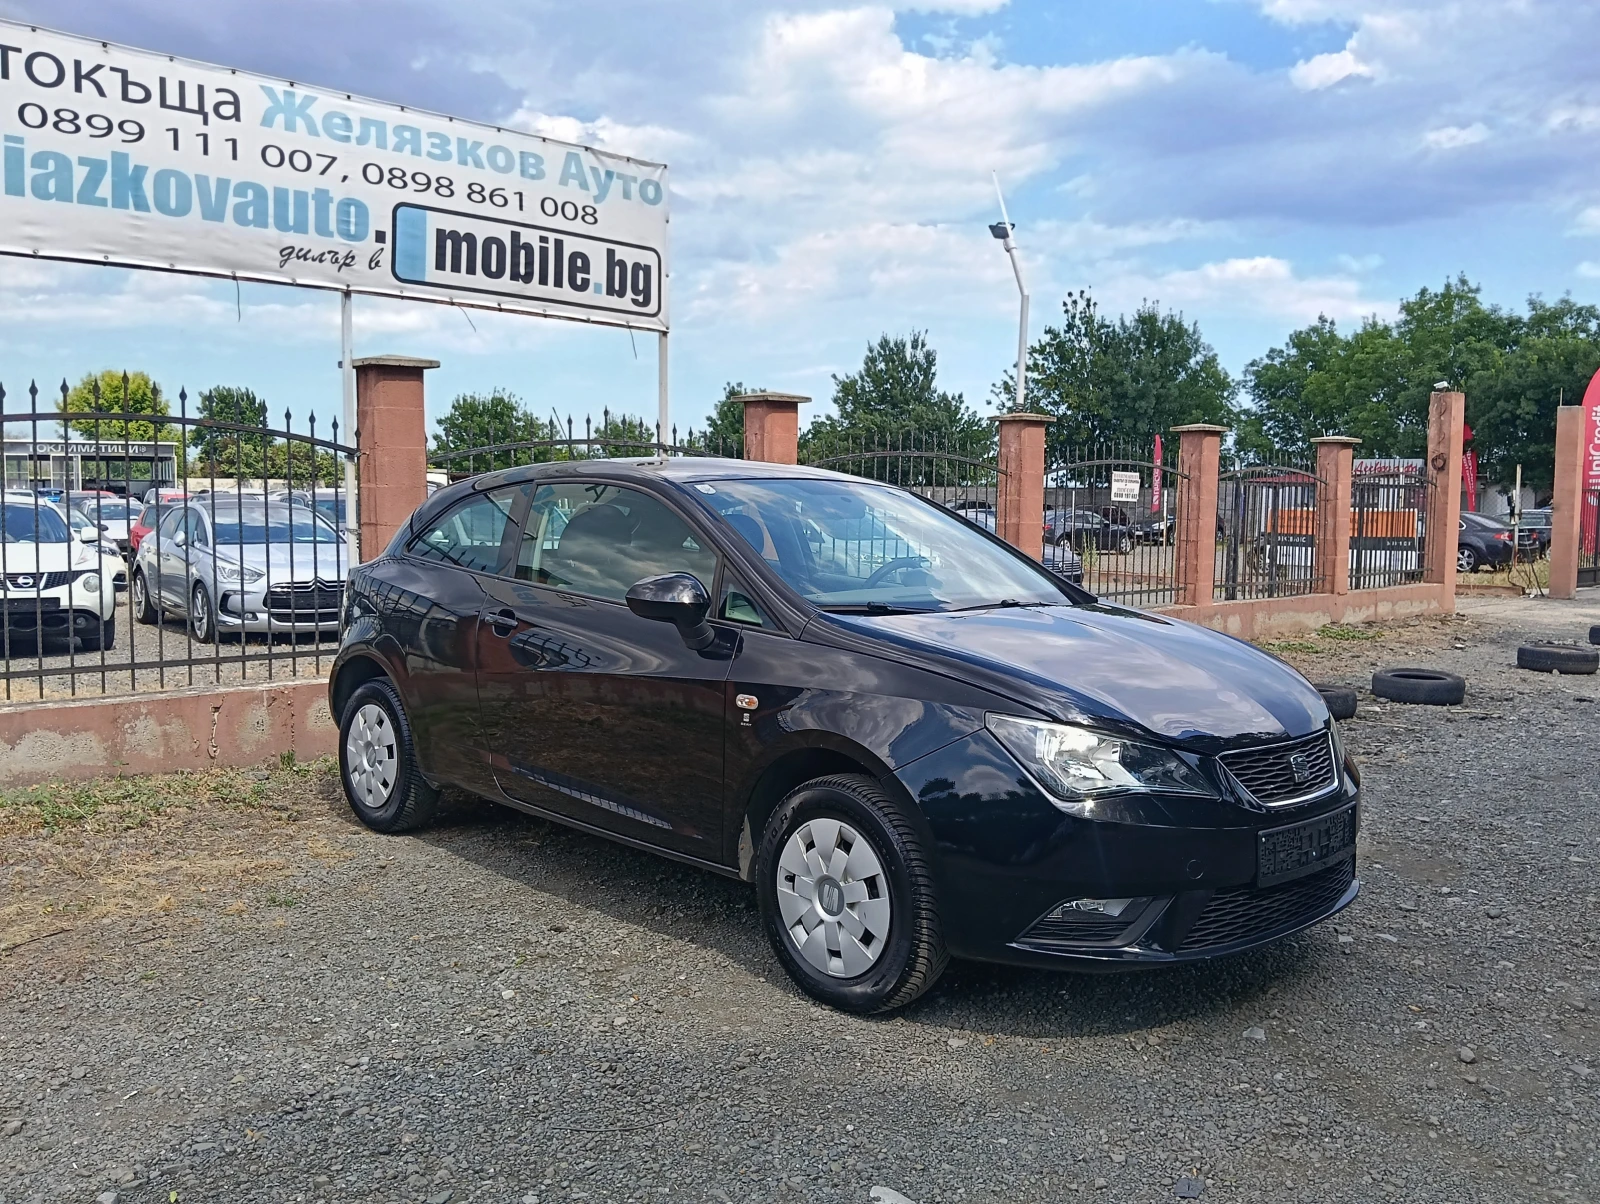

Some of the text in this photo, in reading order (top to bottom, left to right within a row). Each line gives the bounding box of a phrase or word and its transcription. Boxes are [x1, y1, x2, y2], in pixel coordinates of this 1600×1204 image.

[17, 102, 599, 225] 0899 111 007, 0898 861 008
[258, 84, 546, 181] Желязков
[559, 151, 663, 206] Ауто
[279, 245, 382, 272] дилър в
[434, 227, 652, 308] mobile.bg
